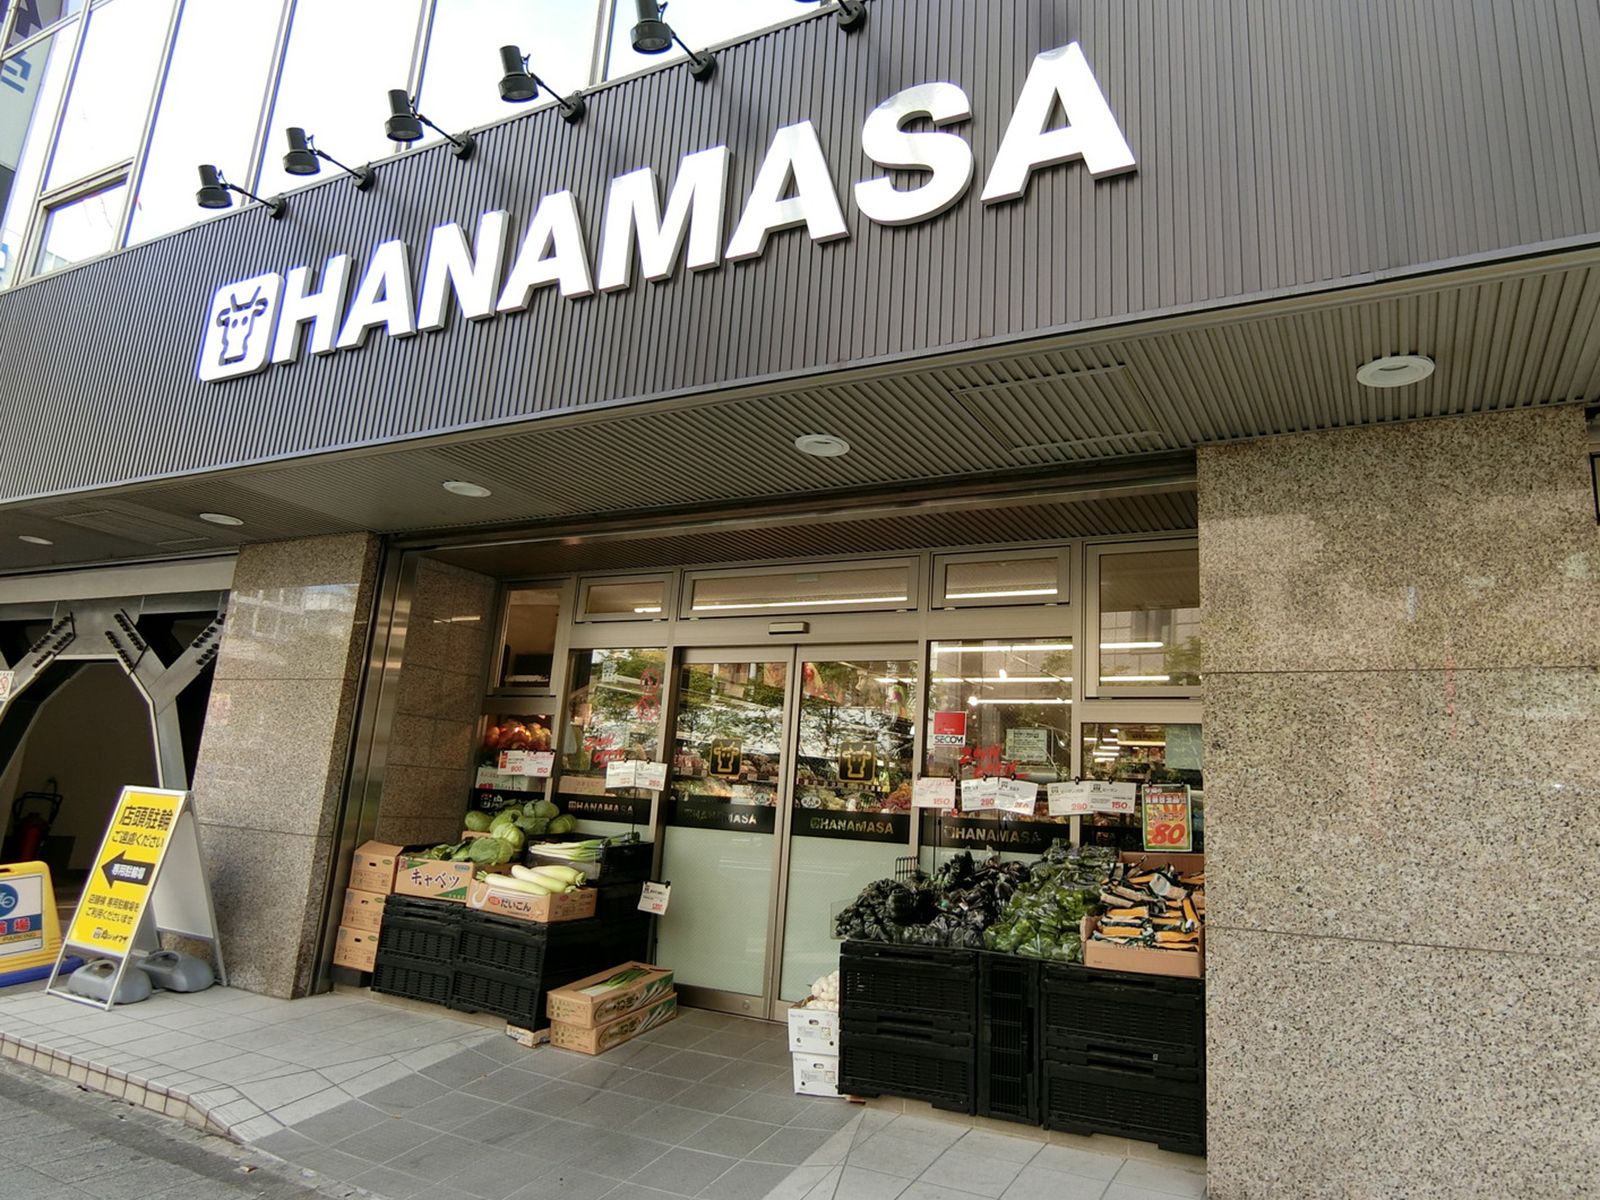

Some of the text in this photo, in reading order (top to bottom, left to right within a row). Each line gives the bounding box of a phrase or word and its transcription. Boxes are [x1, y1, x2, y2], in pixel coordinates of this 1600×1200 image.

[272, 41, 1137, 366] HANAMASA
[934, 735, 963, 744] SECOM
[1111, 801, 1128, 809] 150
[119, 805, 174, 831] 店頭駐輪
[819, 817, 894, 834] HANAMASA
[112, 830, 165, 848] ご遠慮ください
[955, 827, 1041, 843] HANAMASA
[1151, 823, 1185, 844] 80
[410, 868, 460, 890] キャベツ
[500, 898, 532, 913] だいこん
